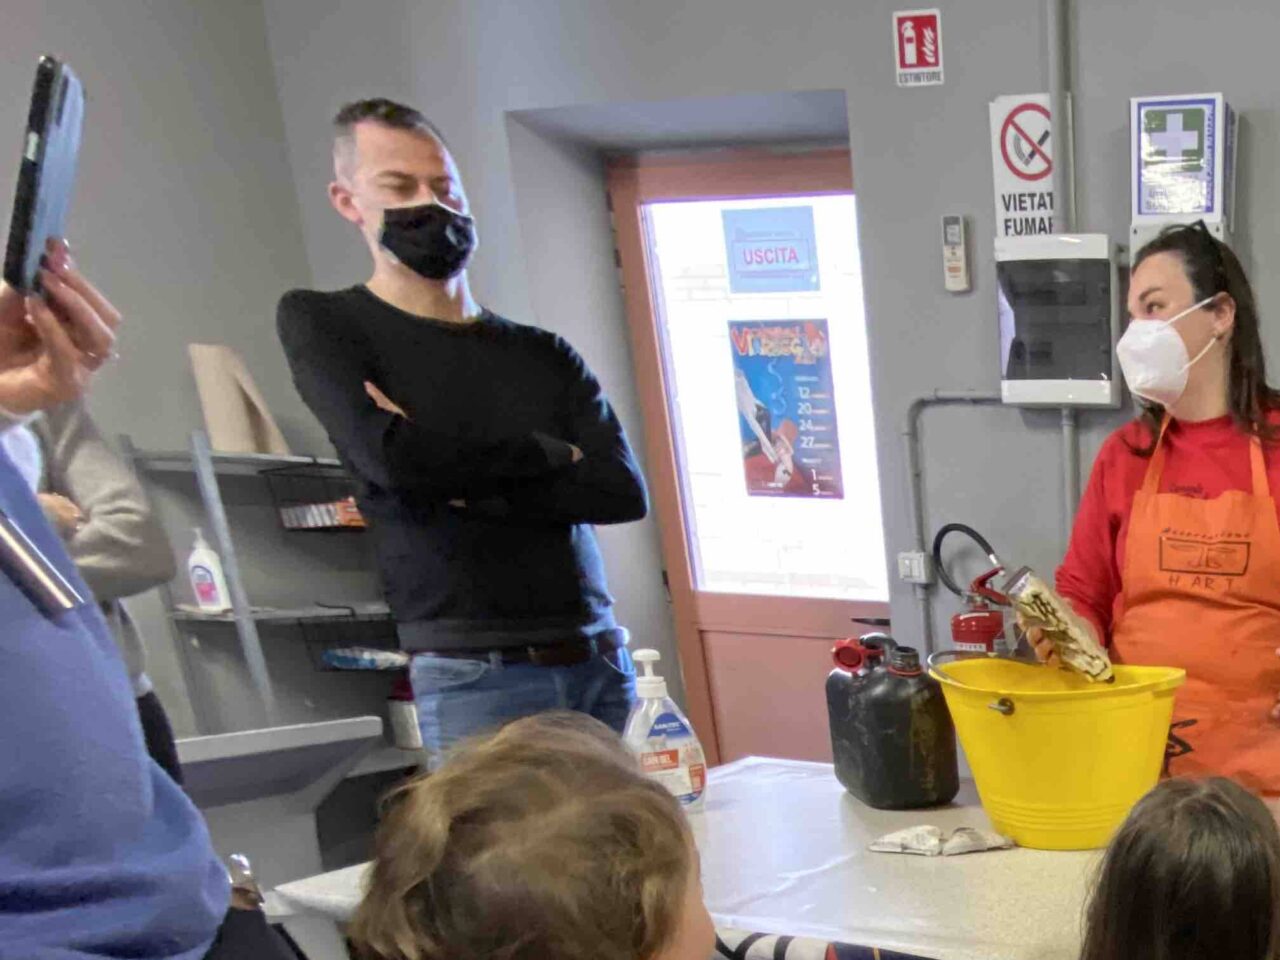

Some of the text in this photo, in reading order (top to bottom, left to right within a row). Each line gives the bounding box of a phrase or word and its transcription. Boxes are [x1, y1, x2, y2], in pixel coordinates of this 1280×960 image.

[1002, 192, 1054, 211] VIETAT
[1004, 217, 1054, 236] FUMA
[743, 246, 800, 265] USCITA
[797, 386, 810, 399] 12
[797, 402, 812, 415] 20
[798, 419, 813, 431] 24
[800, 436, 815, 448] 27
[811, 468, 817, 480] 1
[812, 484, 820, 495] 5
